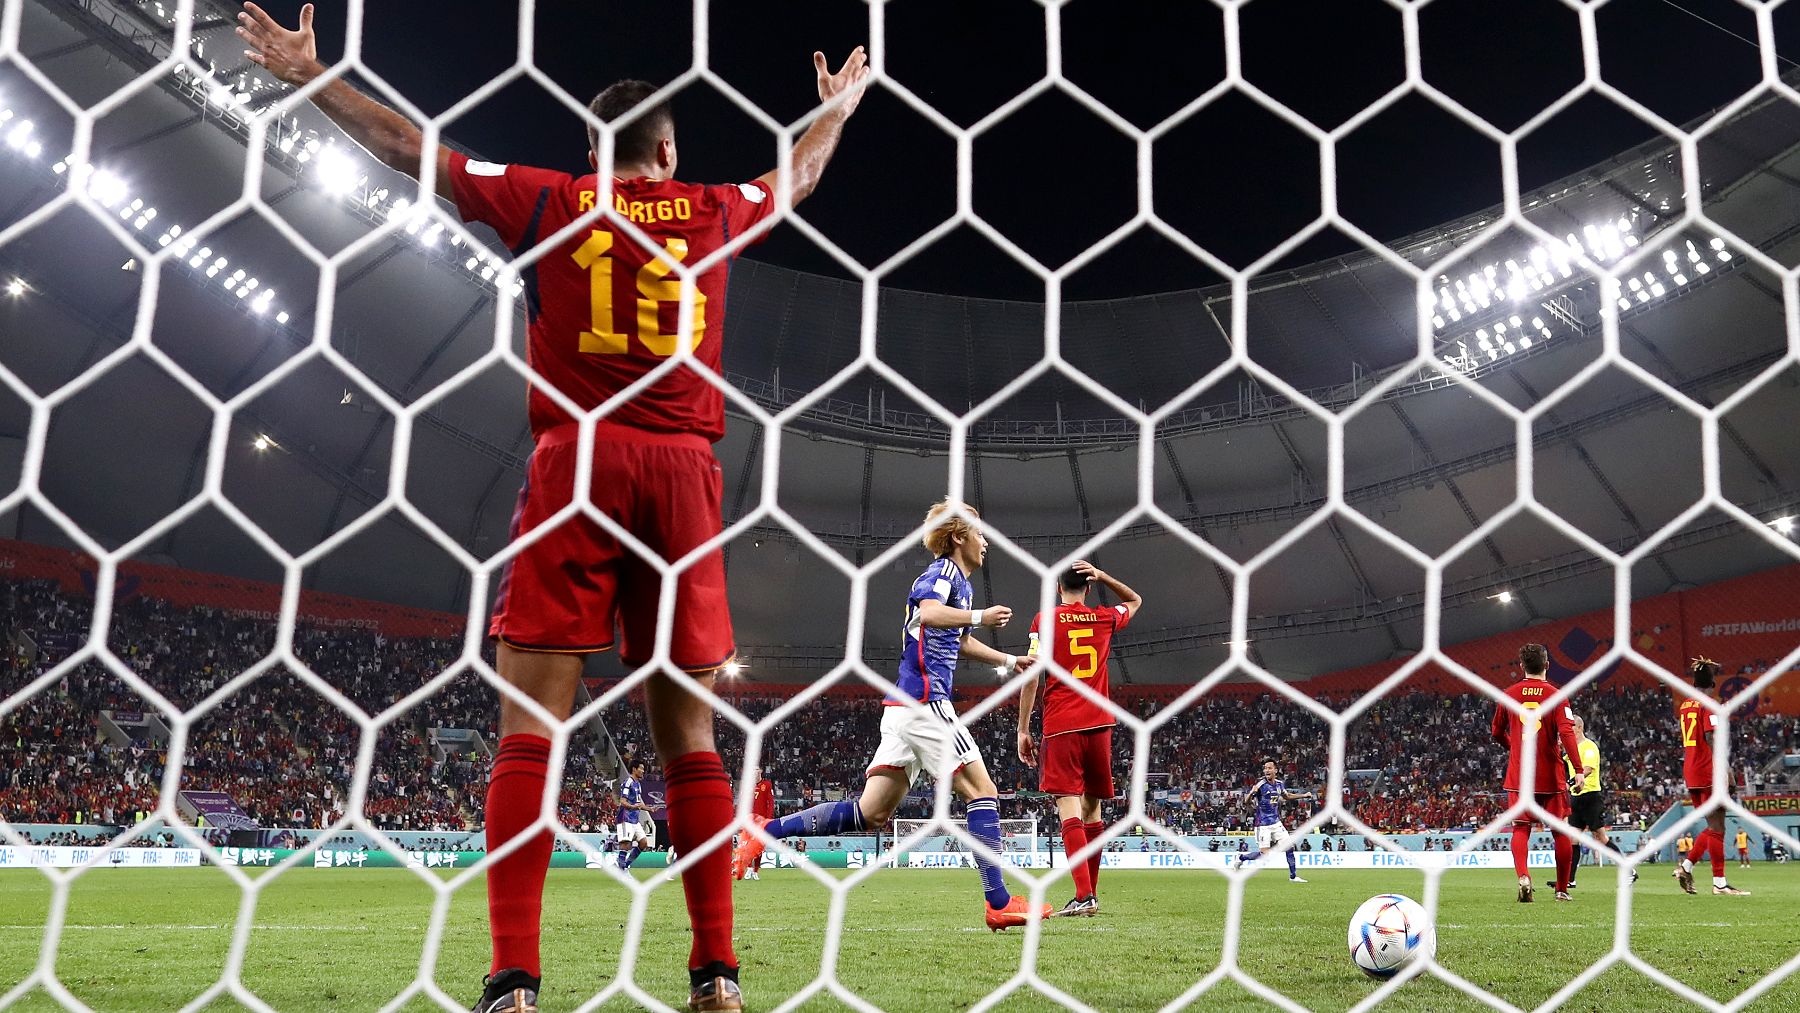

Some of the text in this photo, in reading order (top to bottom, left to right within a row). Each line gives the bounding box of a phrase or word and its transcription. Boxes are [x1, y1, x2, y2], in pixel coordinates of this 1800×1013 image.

[579, 188, 691, 223] RDRIGO
[571, 230, 707, 356] 16
[1067, 628, 1098, 679] 5
